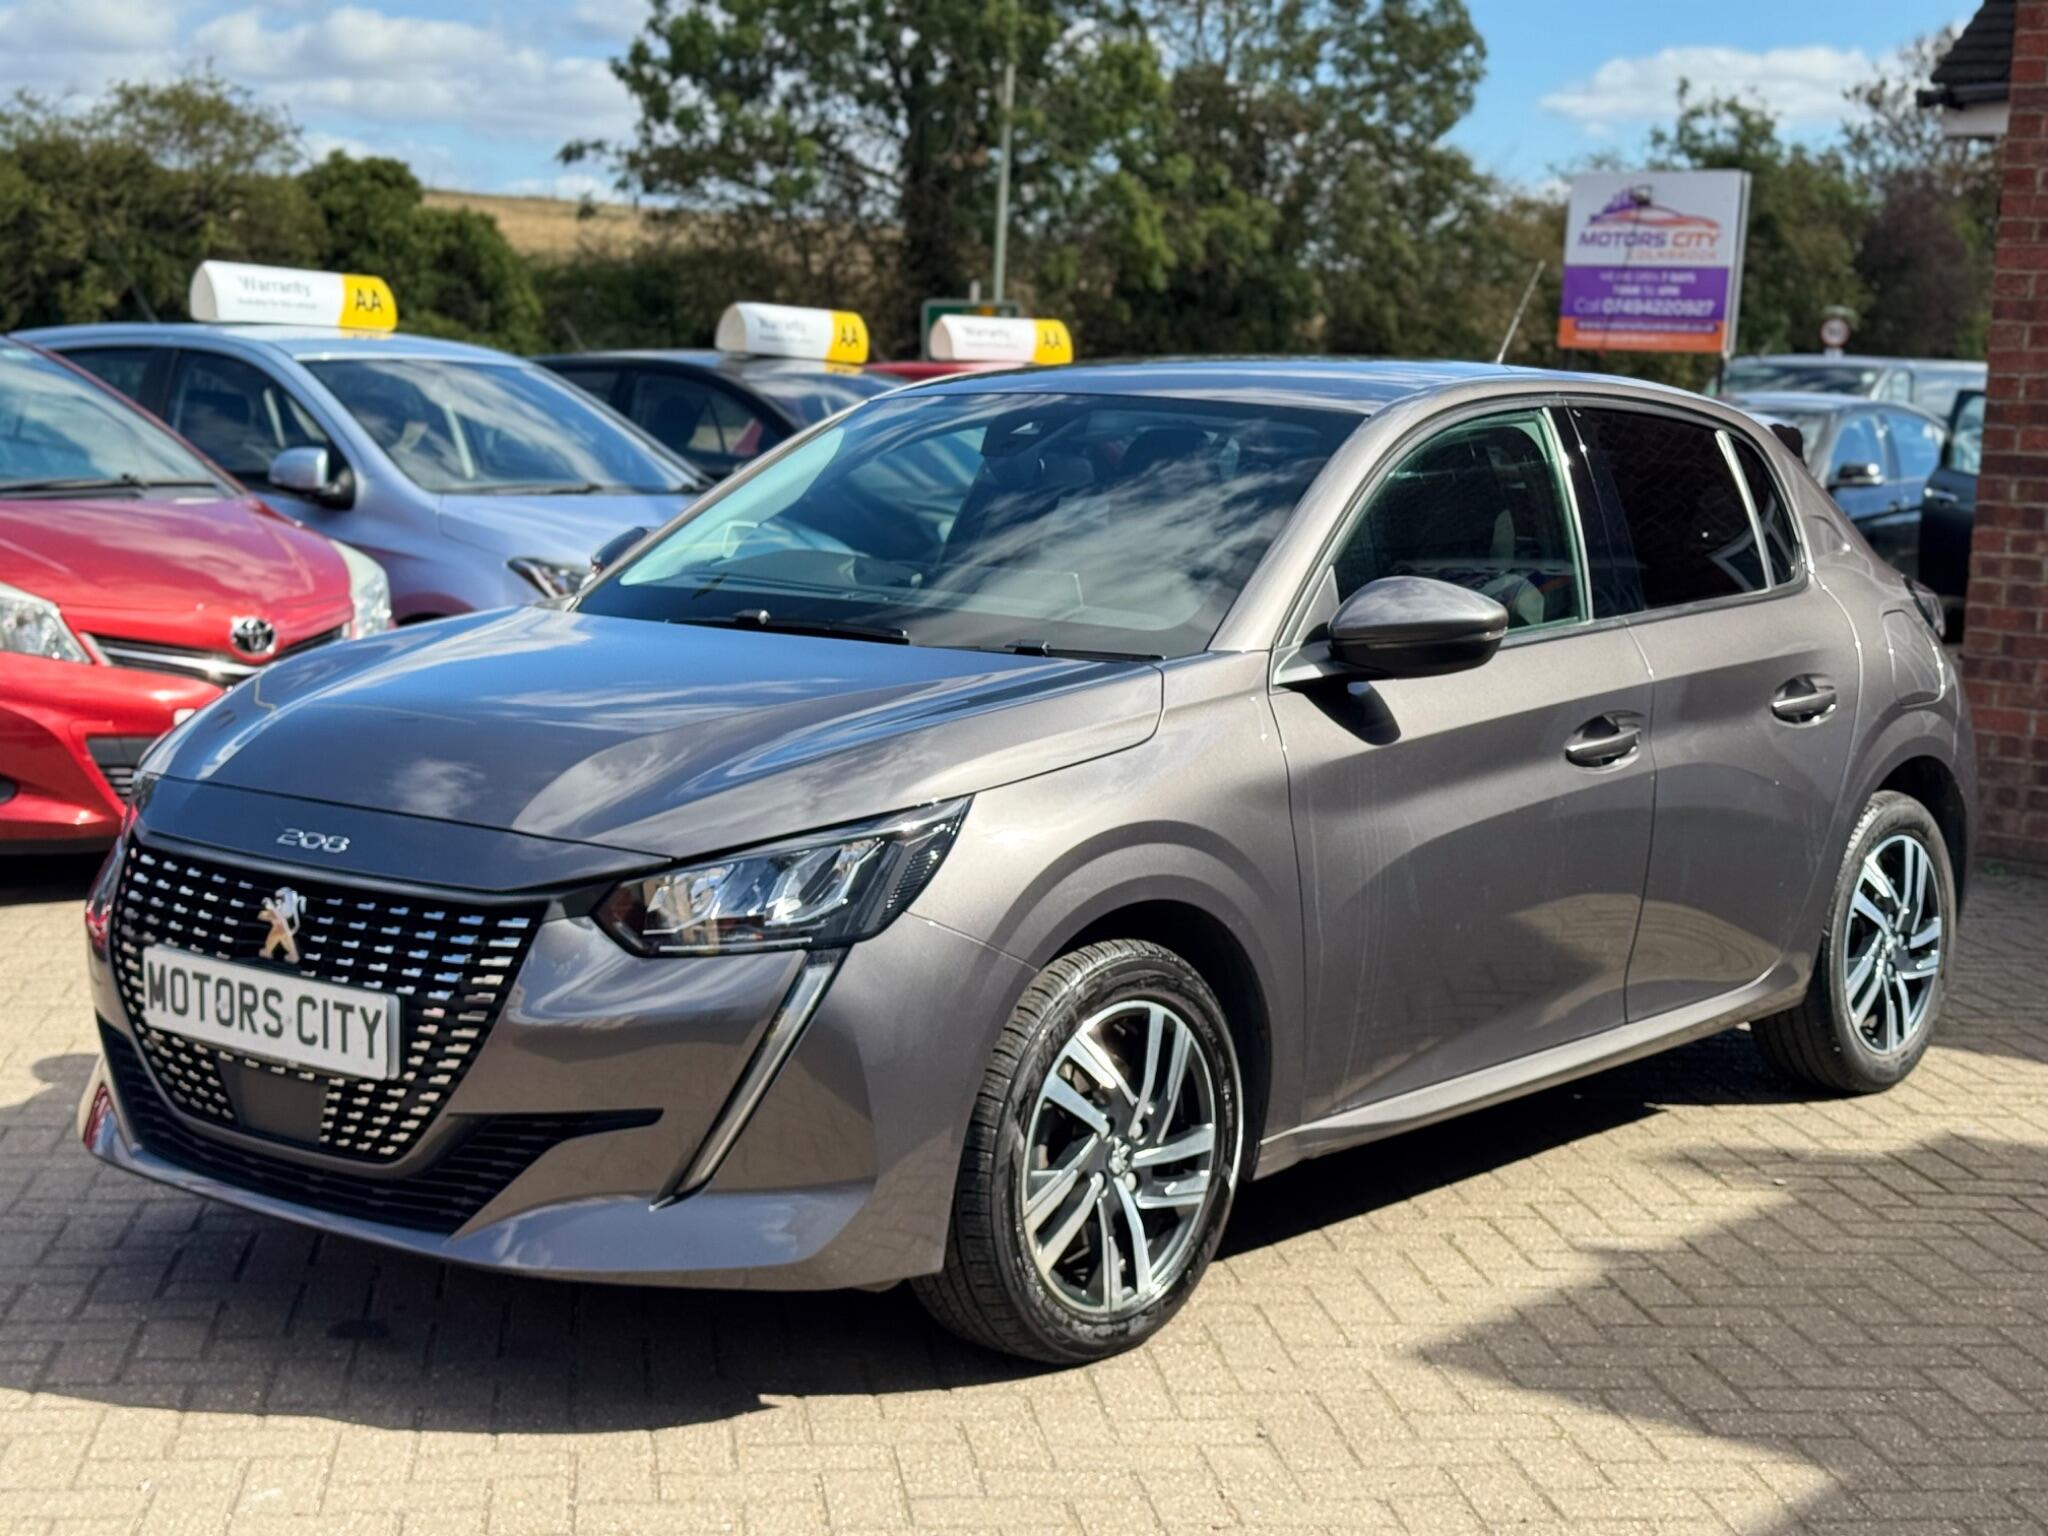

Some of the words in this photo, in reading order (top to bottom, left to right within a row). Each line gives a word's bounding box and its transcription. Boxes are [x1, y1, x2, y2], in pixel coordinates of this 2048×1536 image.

[1578, 230, 1668, 247] MOTORS
[1672, 231, 1721, 248] CITY
[237, 275, 312, 298] Warranty
[354, 288, 384, 312] AA
[839, 323, 860, 347] AA
[276, 827, 351, 854] 208
[147, 960, 284, 1039] MOTORS
[296, 994, 383, 1060] CITY
